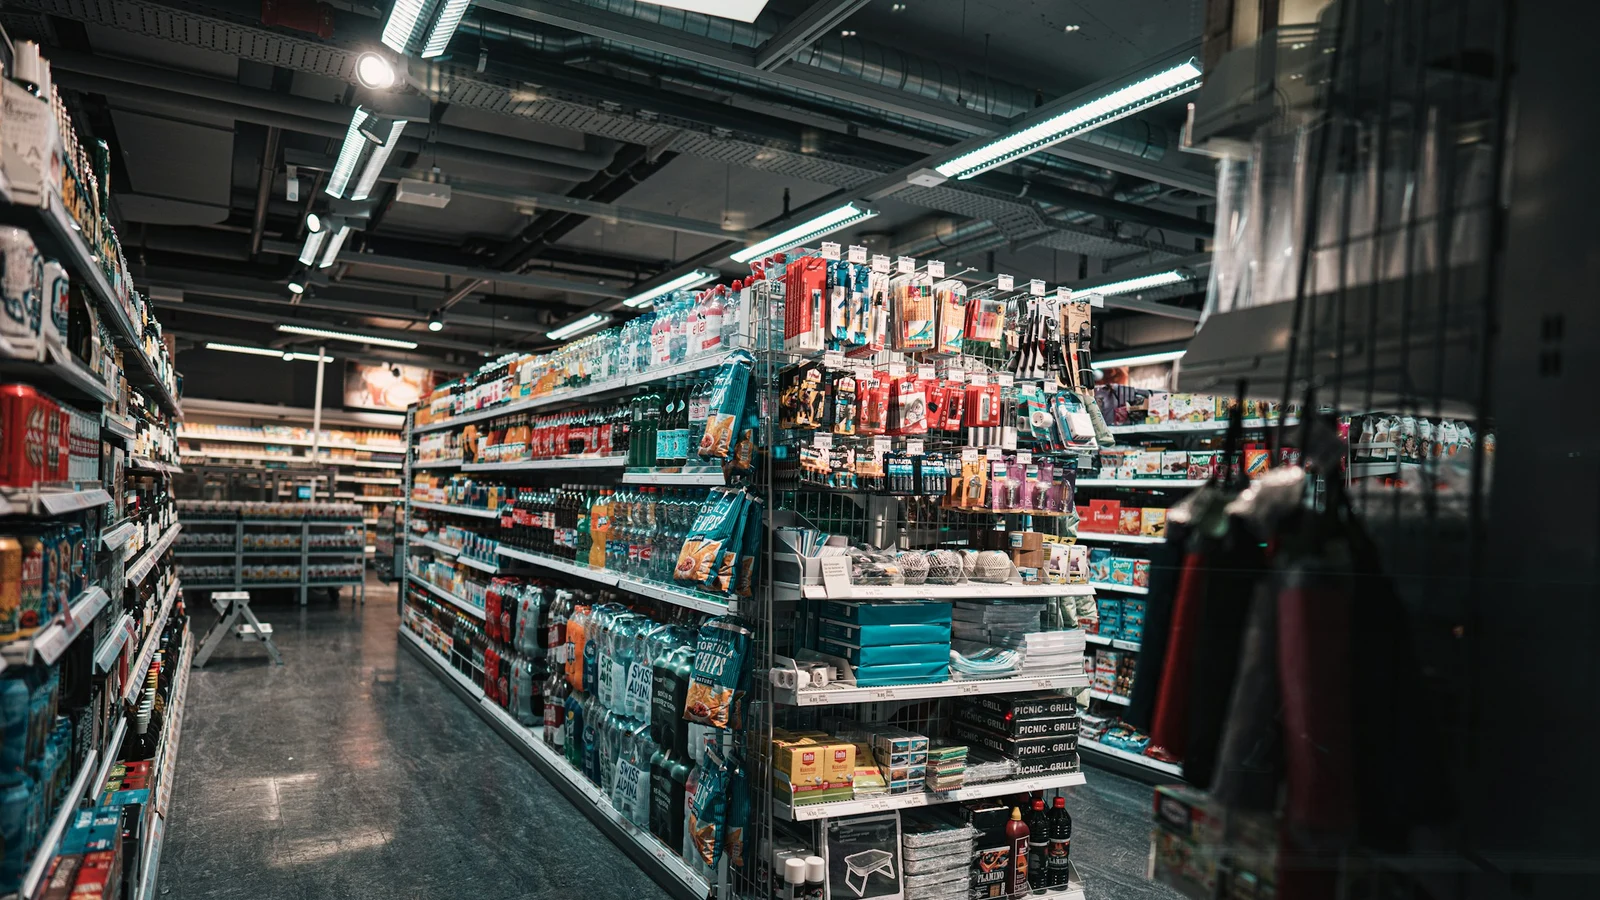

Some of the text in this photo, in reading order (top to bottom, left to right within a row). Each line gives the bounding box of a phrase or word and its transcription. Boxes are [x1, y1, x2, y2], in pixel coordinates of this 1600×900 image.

[901, 383, 913, 393] Pritt
[1190, 455, 1211, 464] Country
[1113, 561, 1132, 570] Country
[697, 641, 734, 659] TORTILLA
[694, 651, 727, 676] CHIPS
[982, 700, 1002, 712] GRILL
[1014, 704, 1043, 715] PICNIC
[1050, 703, 1074, 712] GRILL
[960, 711, 981, 723] PICNIC
[987, 718, 1006, 731] GRILL
[1019, 724, 1048, 734] PICNIC
[1054, 723, 1077, 732] GRILL
[957, 729, 978, 742] PICNIC
[984, 739, 1004, 751] GRILL
[1018, 744, 1046, 755] PICNIC
[1053, 742, 1076, 752] GRILL
[620, 761, 640, 784] SWISS
[1016, 764, 1044, 775] PICNIC
[1050, 760, 1073, 771] GRILL
[616, 776, 637, 801] ALPINA
[977, 871, 1004, 884] FLAMINO
